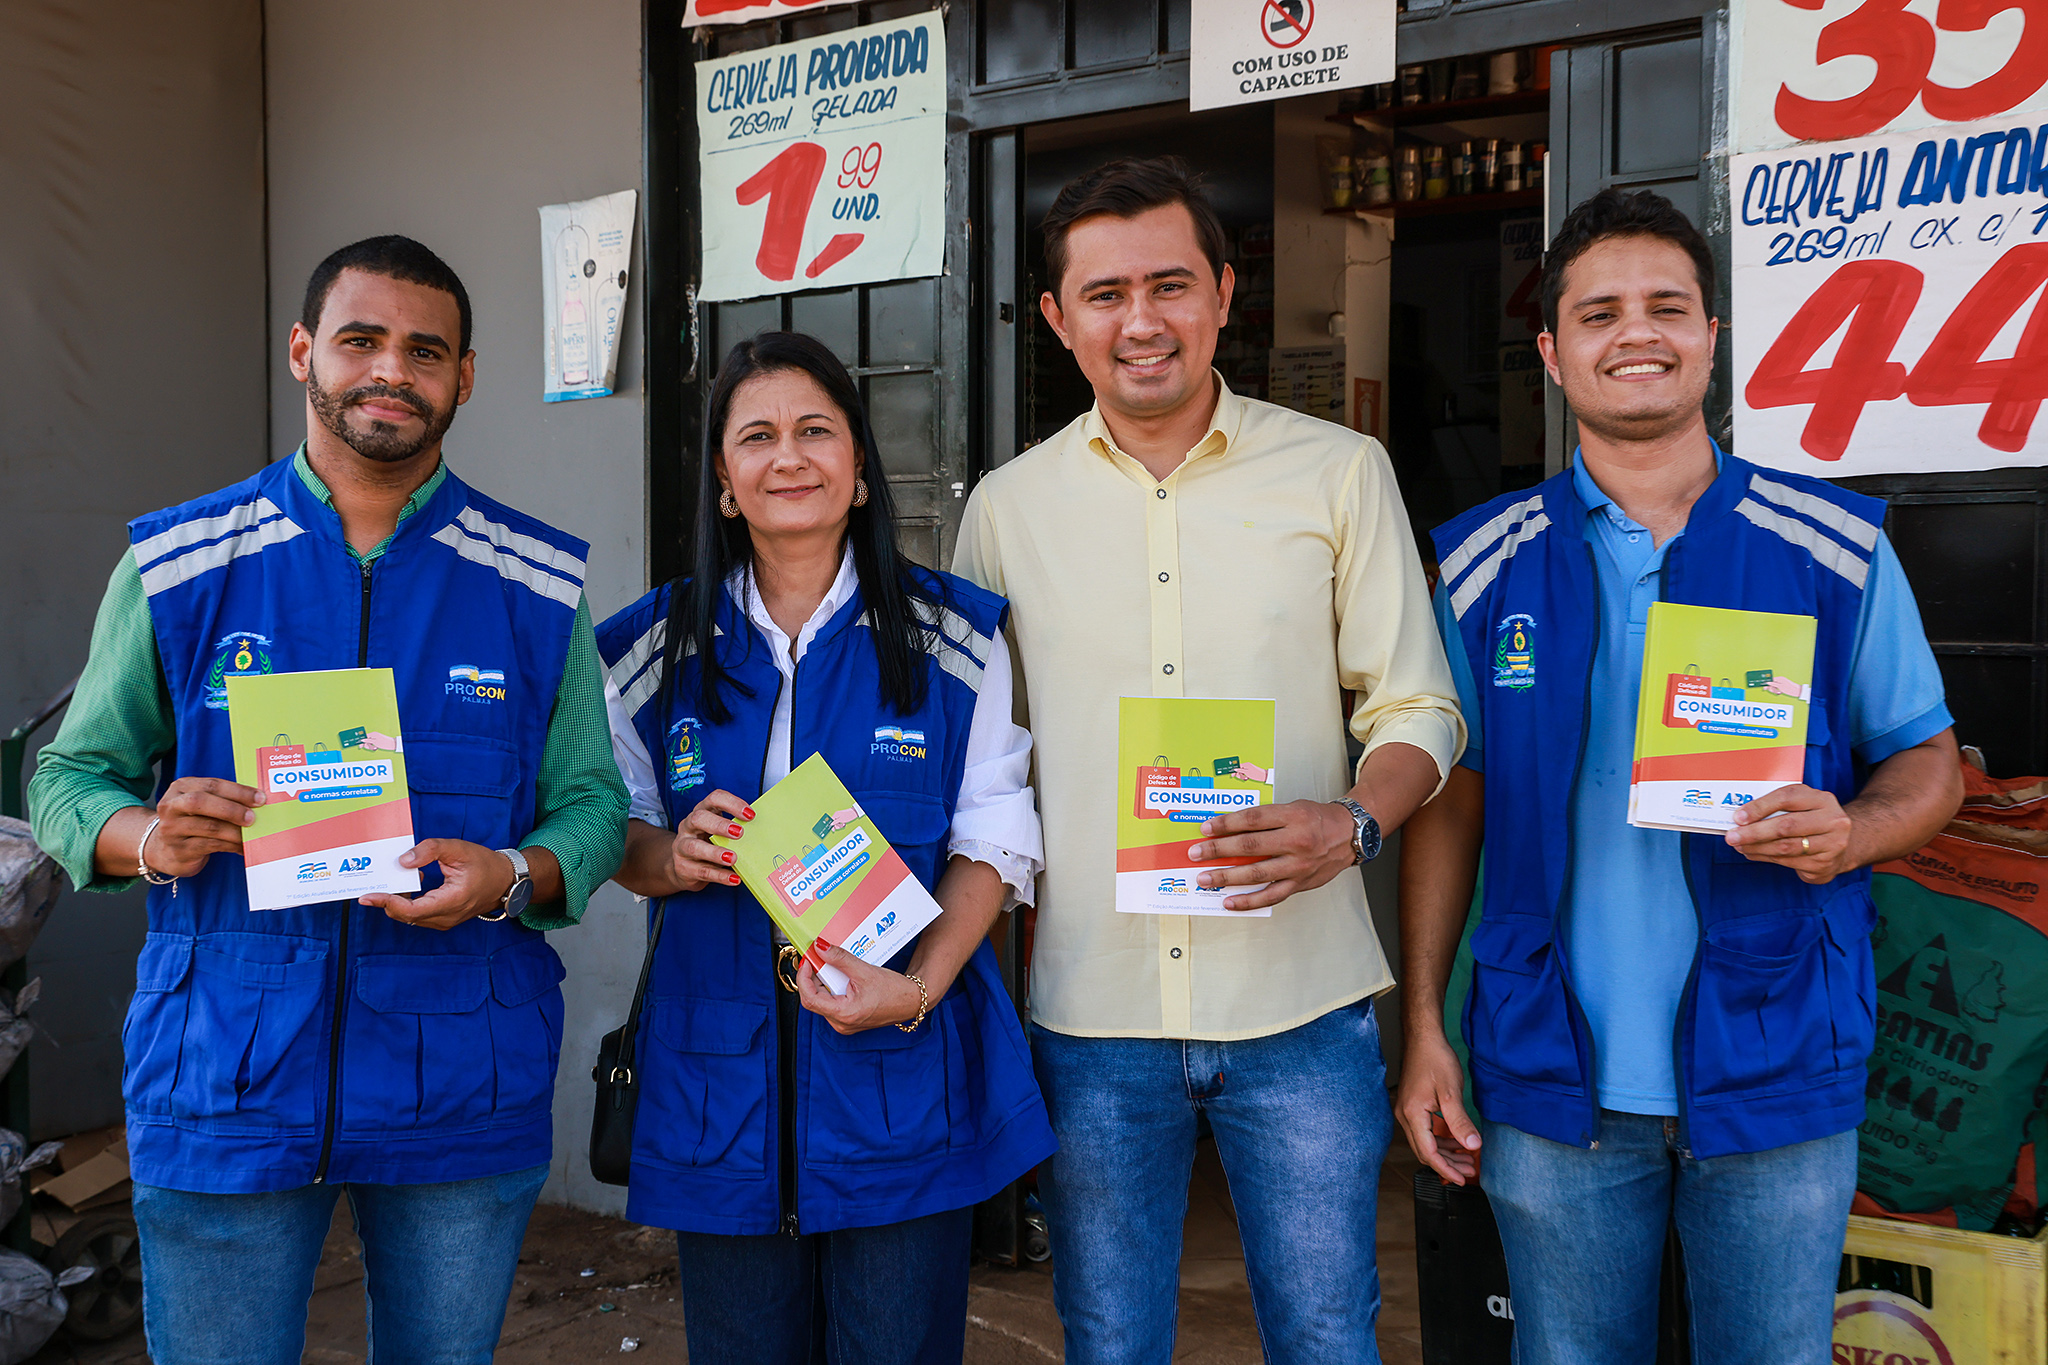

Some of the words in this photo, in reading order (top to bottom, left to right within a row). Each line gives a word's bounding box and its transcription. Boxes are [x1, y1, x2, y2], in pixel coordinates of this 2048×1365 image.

[707, 53, 798, 114] CERVEJA
[804, 26, 929, 96] PROIBIDA
[1232, 56, 1273, 75] COM
[1278, 50, 1317, 68] USO
[1321, 44, 1349, 62] DE
[1239, 67, 1340, 94] CAPACETE
[728, 107, 793, 140] 269ml
[811, 87, 898, 126] GELADA
[1743, 147, 1888, 227] CERVEJA
[832, 193, 881, 222] UND.
[1766, 221, 1891, 266] 269ml
[445, 683, 506, 701] PROCON
[462, 696, 491, 704] PALMAS
[1678, 700, 1787, 720] CONSUMIDOR
[871, 743, 926, 759] PROCON
[887, 755, 912, 763] PALMAS
[273, 765, 388, 785] CONSUMIDOR
[311, 791, 340, 799] normas
[341, 787, 378, 796] correlatas
[1149, 792, 1255, 805] CONSUMIDOR
[297, 871, 331, 880] PROCON
[790, 833, 865, 897] CONSUMIDOR
[855, 939, 875, 957] ROCON
[1889, 1050, 1979, 1094] Citriodora
[1857, 1119, 1910, 1149] UIDO
